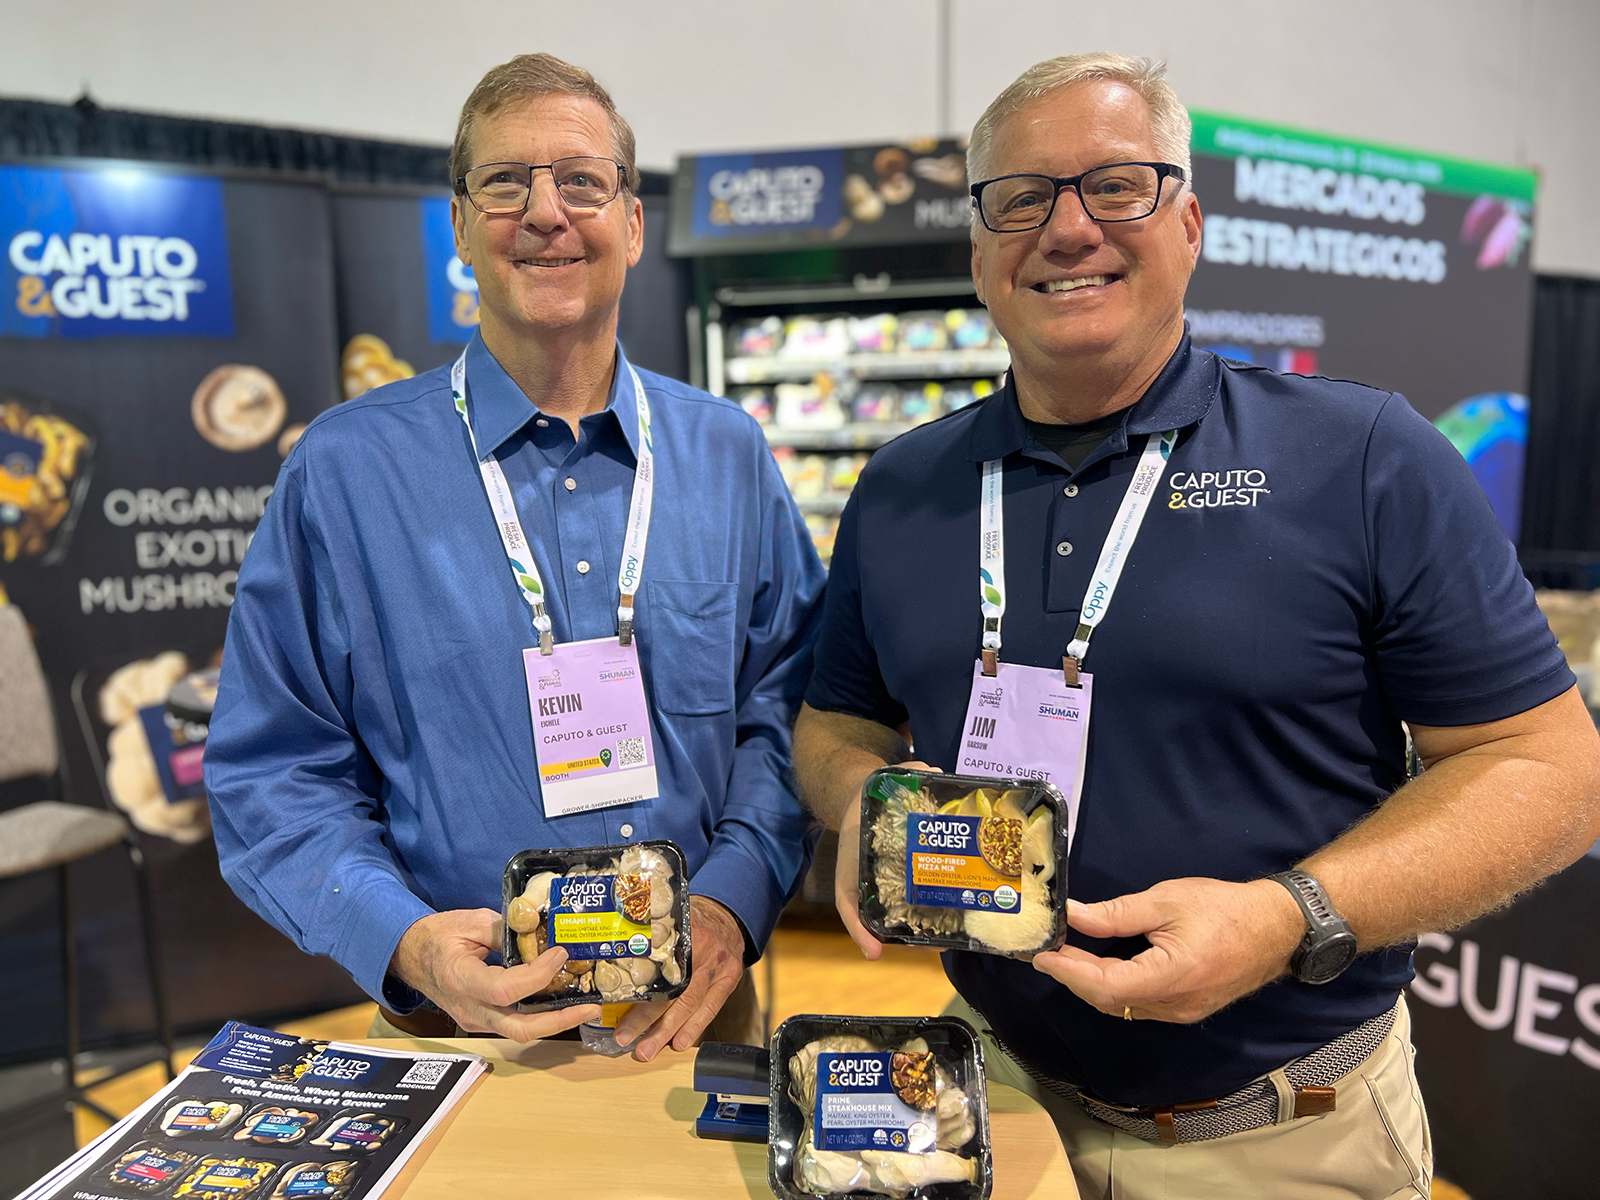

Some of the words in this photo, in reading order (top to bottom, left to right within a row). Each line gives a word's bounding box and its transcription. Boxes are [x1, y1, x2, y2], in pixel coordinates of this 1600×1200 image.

[1234, 157, 1426, 226] MERCADOS
[8, 230, 198, 279] CAPUTO
[1203, 213, 1447, 285] ESTRATEGICOS
[1132, 472, 1147, 495] FRESH
[1139, 465, 1158, 496] PRODUCE
[1169, 469, 1267, 490] CAPUTO
[503, 522, 518, 551] PRODUCE
[509, 521, 520, 542] FRESH
[1105, 552, 1118, 573] Expect
[1114, 541, 1122, 552] the
[1118, 524, 1128, 540] world
[1124, 510, 1134, 524] from
[135, 529, 254, 569] EXOTI
[622, 555, 639, 588] Oppy
[1083, 580, 1109, 620] Oppy
[599, 670, 635, 680] SHUMAN
[538, 693, 582, 716] KEVIN
[1038, 706, 1080, 719] SHUMAN
[544, 730, 584, 744] CAPUTO
[586, 728, 594, 738] &
[596, 724, 628, 736] GUEST
[969, 716, 996, 739] JIM
[966, 740, 988, 751] GARSOW
[566, 760, 584, 769] UNITED
[583, 758, 600, 767] STATES
[964, 758, 1004, 772] CAPUTO
[1006, 765, 1013, 775] &
[1016, 766, 1052, 781] GUEST
[545, 772, 570, 782] BOOTH
[918, 820, 970, 836] CAPUTO
[918, 856, 966, 866] WOOD-FIRED
[561, 882, 606, 896] CAPUTO
[946, 879, 982, 888] MUSHROOMS
[587, 917, 602, 925] MIX
[312, 1056, 371, 1072] CAPUTO
[828, 1060, 882, 1073] CAPUTO
[221, 1074, 258, 1088] Fresh,
[260, 1080, 300, 1094] Exotic,
[303, 1086, 340, 1098] Whole
[341, 1090, 410, 1101] Mushrooms
[230, 1086, 262, 1097] From
[262, 1090, 322, 1104] America's
[323, 1098, 340, 1106] #1
[341, 1098, 386, 1109] Grower
[828, 1104, 876, 1112] STEAKHOUSE
[878, 1104, 892, 1112] MIX
[72, 1191, 100, 1200] What
